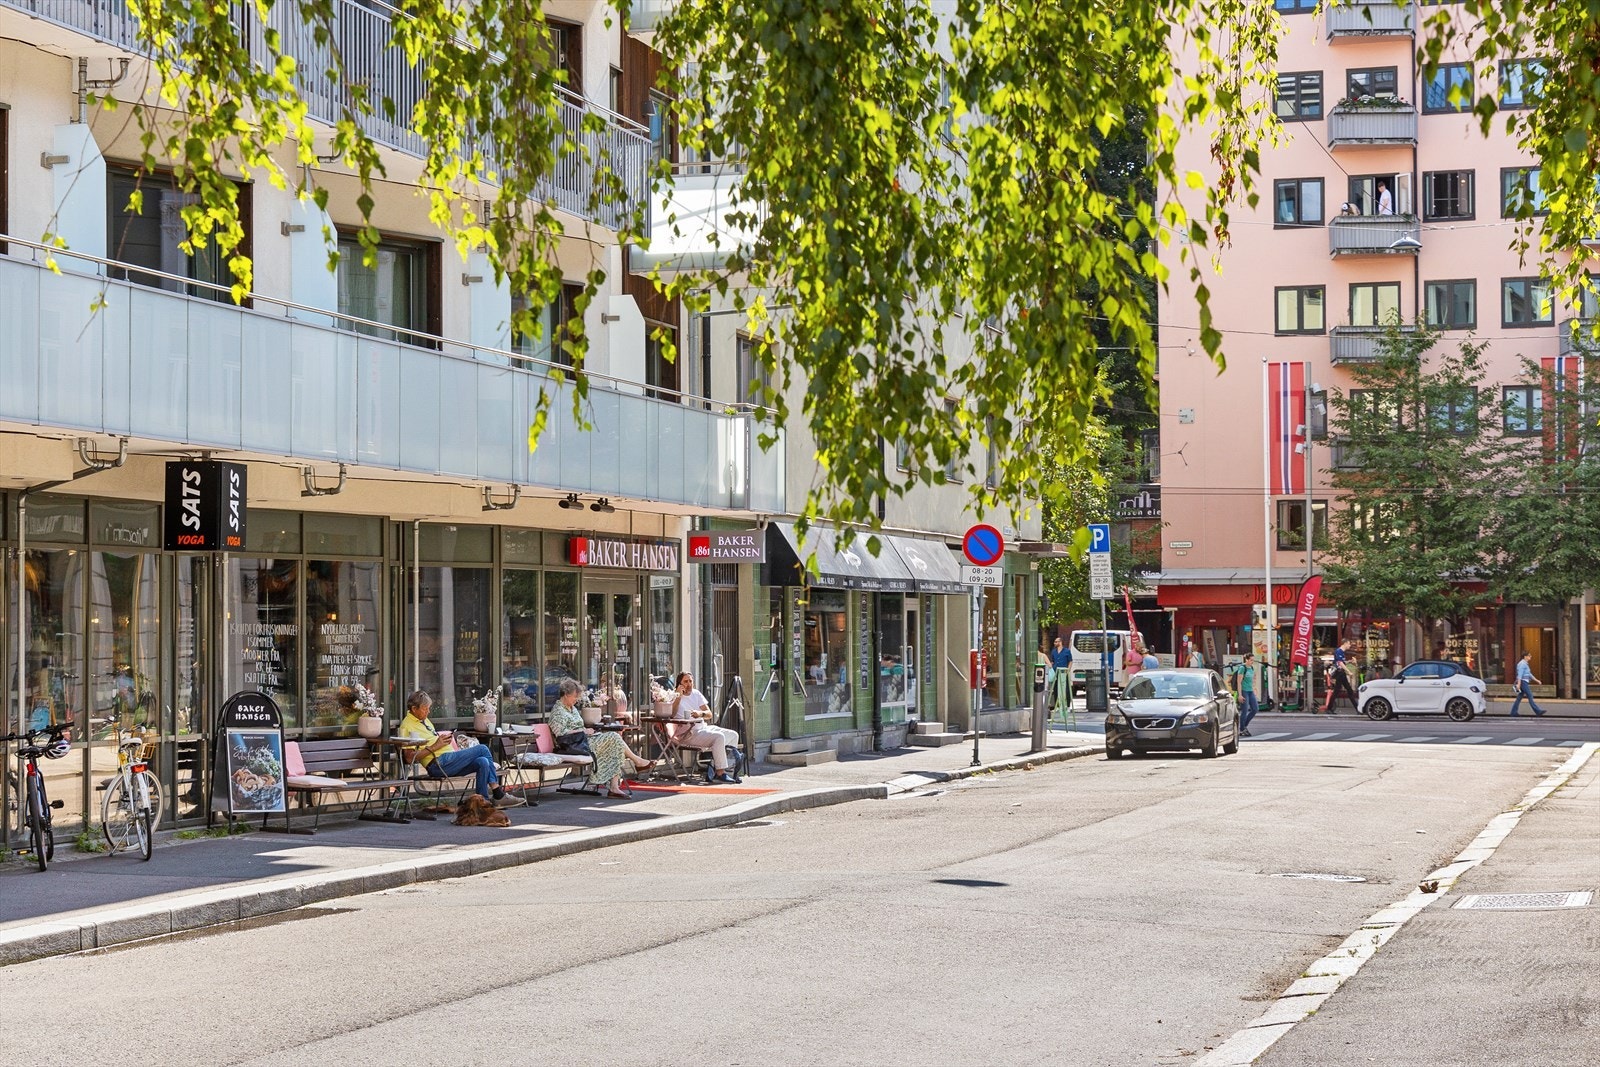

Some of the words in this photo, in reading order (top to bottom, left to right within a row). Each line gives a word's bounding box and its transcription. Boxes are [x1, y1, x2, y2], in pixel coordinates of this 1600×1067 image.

[181, 467, 201, 531] SATS
[229, 469, 240, 533] SATS
[177, 535, 205, 545] YOGA
[226, 535, 241, 547] YOGA
[718, 536, 755, 546] BAKER
[1093, 529, 1104, 549] P
[588, 540, 627, 567] BAKER
[631, 543, 678, 571] HANSEN
[694, 545, 710, 556] 1861
[712, 547, 760, 558] HANSEN
[969, 575, 995, 583] (09-20)
[1301, 593, 1314, 616] Luca
[1295, 637, 1308, 657] Deli
[1445, 639, 1479, 648] COFFEE
